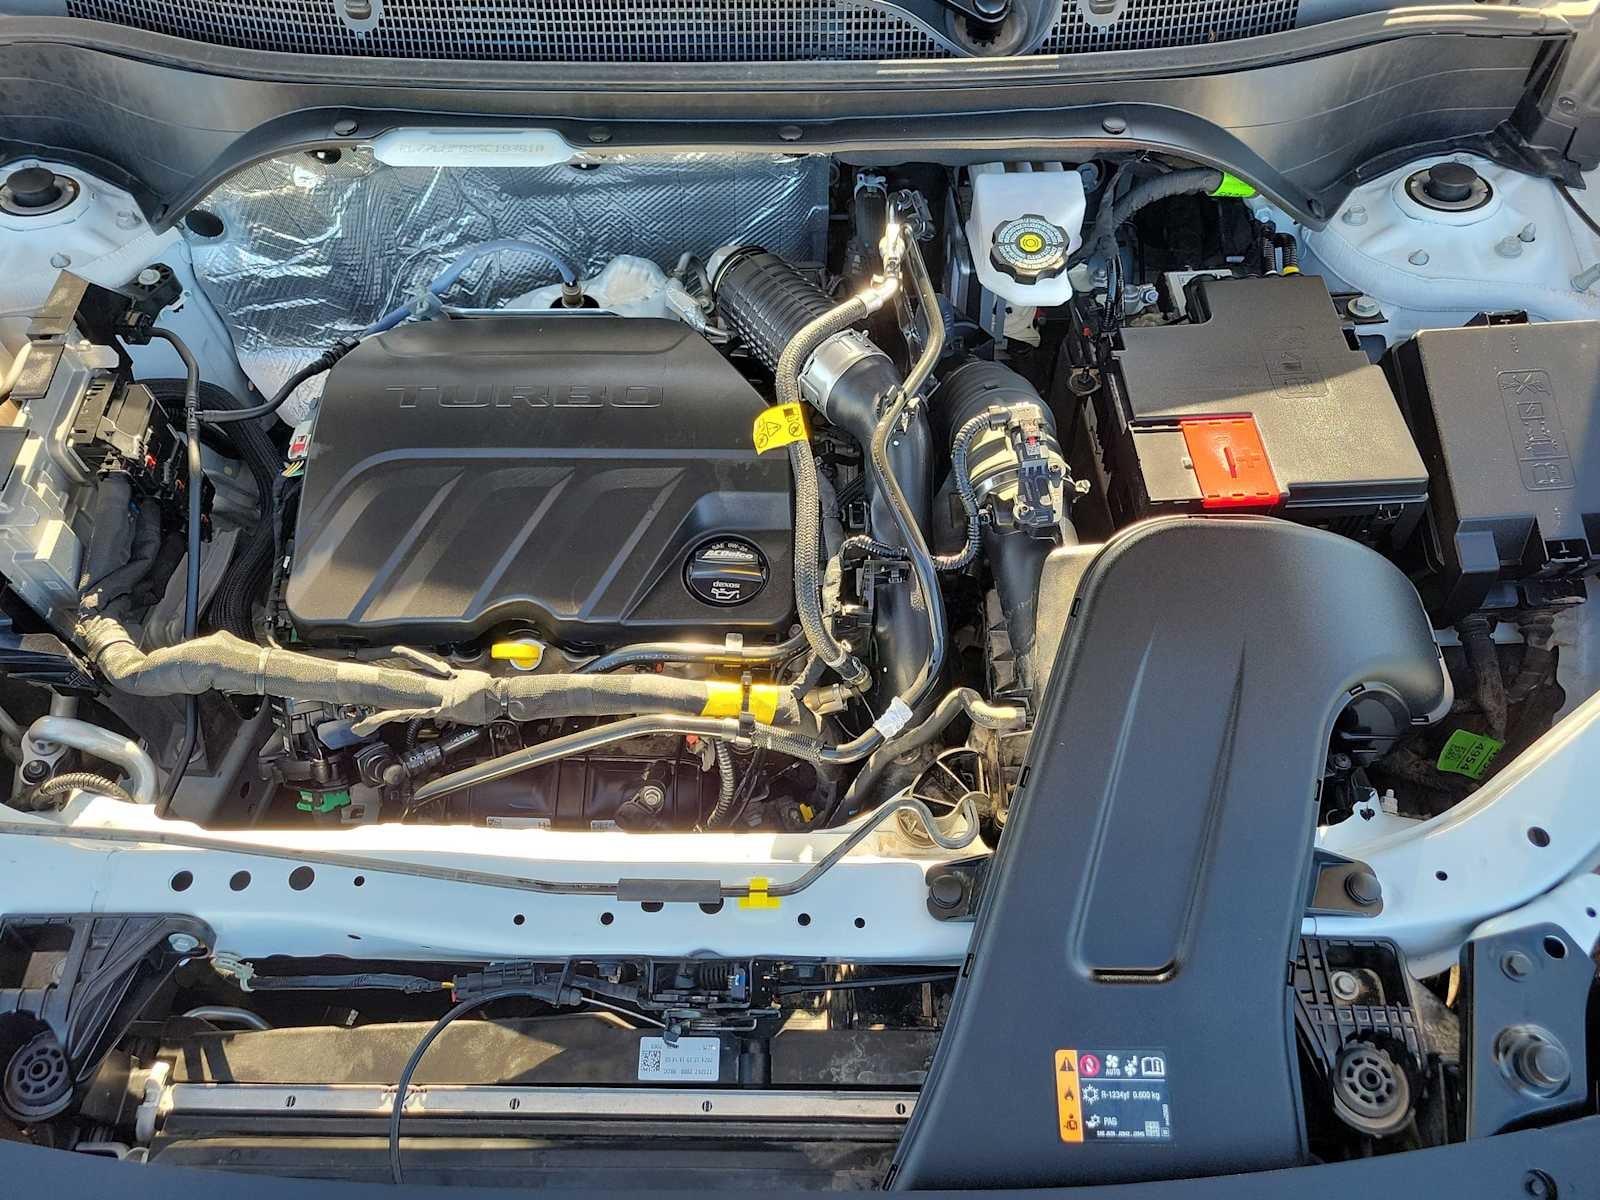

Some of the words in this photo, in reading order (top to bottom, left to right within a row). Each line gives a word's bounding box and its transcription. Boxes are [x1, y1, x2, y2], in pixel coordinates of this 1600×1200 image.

[385, 383, 664, 408] TURBO
[702, 550, 754, 559] ACDelco
[712, 580, 741, 589] dexos
[1105, 1068, 1121, 1076] AUTO
[1101, 1090, 1130, 1101] R-1234yf
[1103, 1116, 1118, 1127] PAG
